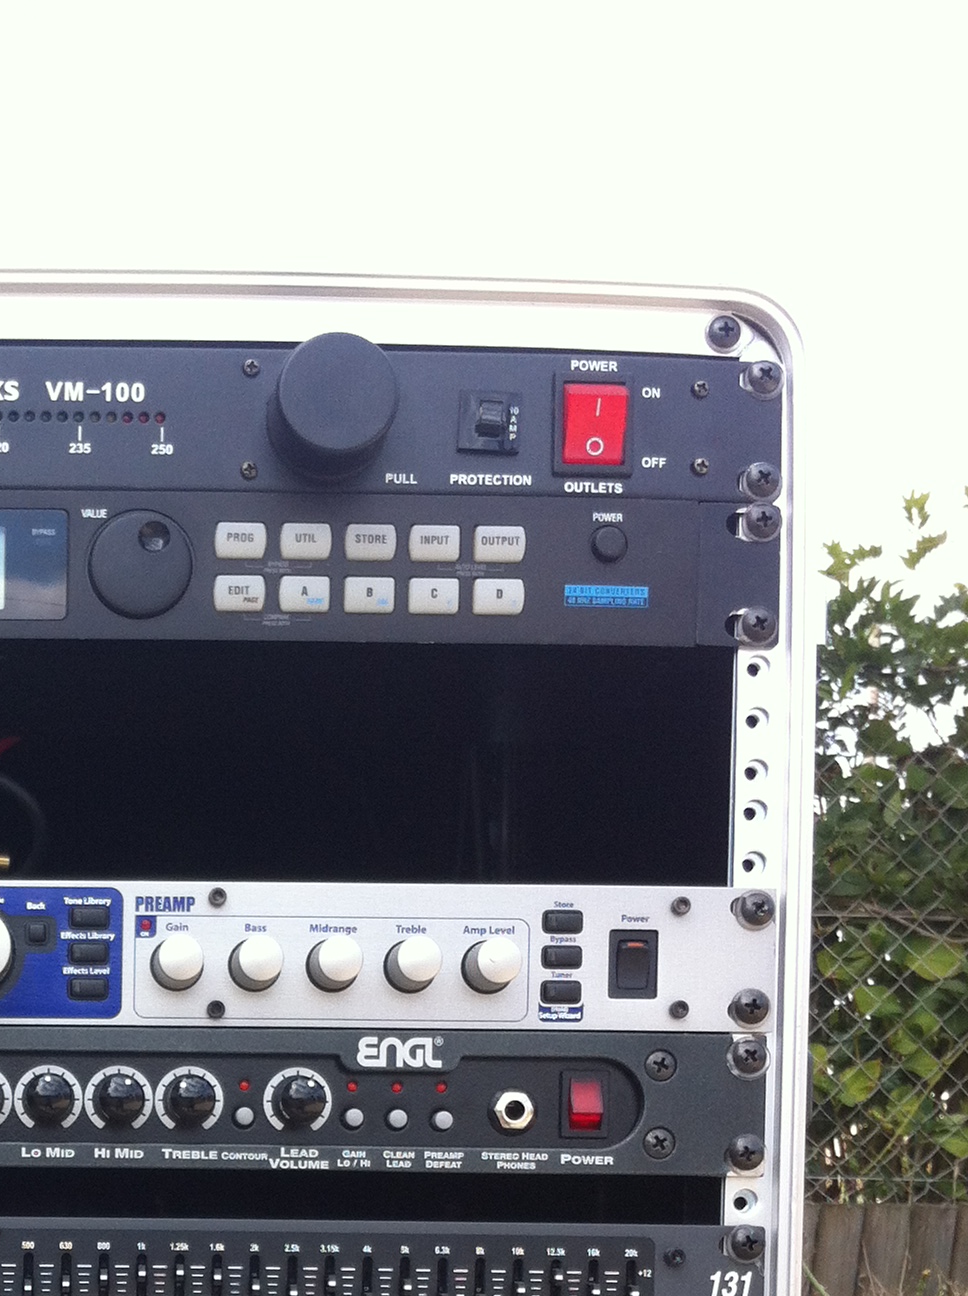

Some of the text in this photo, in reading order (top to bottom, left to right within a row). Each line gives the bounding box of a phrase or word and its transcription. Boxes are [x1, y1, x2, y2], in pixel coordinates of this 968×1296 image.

[570, 360, 618, 372] POWER
[45, 381, 145, 402] VM-100
[642, 387, 661, 399] ON
[69, 443, 92, 454] 235
[151, 444, 174, 455] 250
[641, 457, 667, 469] OFF
[385, 473, 417, 485] PULL
[450, 474, 532, 486] PROTECTION
[564, 482, 623, 494] OUTLETS
[81, 509, 107, 519] VALUE
[592, 512, 623, 522] POWER
[226, 532, 255, 543] PROG
[294, 533, 317, 544] UTIL
[354, 533, 388, 545] STORE
[420, 535, 450, 546] INPUT
[481, 536, 520, 546] OUTPUT
[228, 585, 250, 596] EDIT
[301, 586, 308, 596] A
[366, 587, 374, 597] B
[431, 588, 438, 599] C
[496, 589, 504, 599] D
[26, 902, 46, 911] Back
[64, 897, 112, 907] Tone Library
[135, 896, 196, 913] PREAMP
[554, 900, 574, 909] Store
[621, 914, 650, 924] Power
[165, 923, 189, 932] Gain
[244, 924, 267, 933] Bass
[309, 924, 358, 935] Midrange
[395, 925, 427, 935] Treble
[463, 925, 515, 937] Amp Level
[60, 932, 115, 942] Effects Library
[550, 935, 576, 944] Bypass
[62, 967, 110, 975] Effects Level
[551, 971, 573, 979] Tuner
[356, 1036, 443, 1068] ENGL
[162, 1148, 218, 1160] TREBLE
[221, 1152, 268, 1161] CONTOUR
[280, 1147, 319, 1158] LEAD
[342, 1150, 366, 1158] GAIN
[383, 1150, 415, 1159] CLEAN
[424, 1151, 464, 1160] PREAMP
[481, 1152, 548, 1161] STEREO HEAD
[269, 1158, 329, 1169] VOLUME
[386, 1159, 411, 1168] LEAD
[560, 1153, 614, 1165] POWER
[425, 1160, 462, 1169] DEFEAT
[497, 1161, 536, 1170] PHONES
